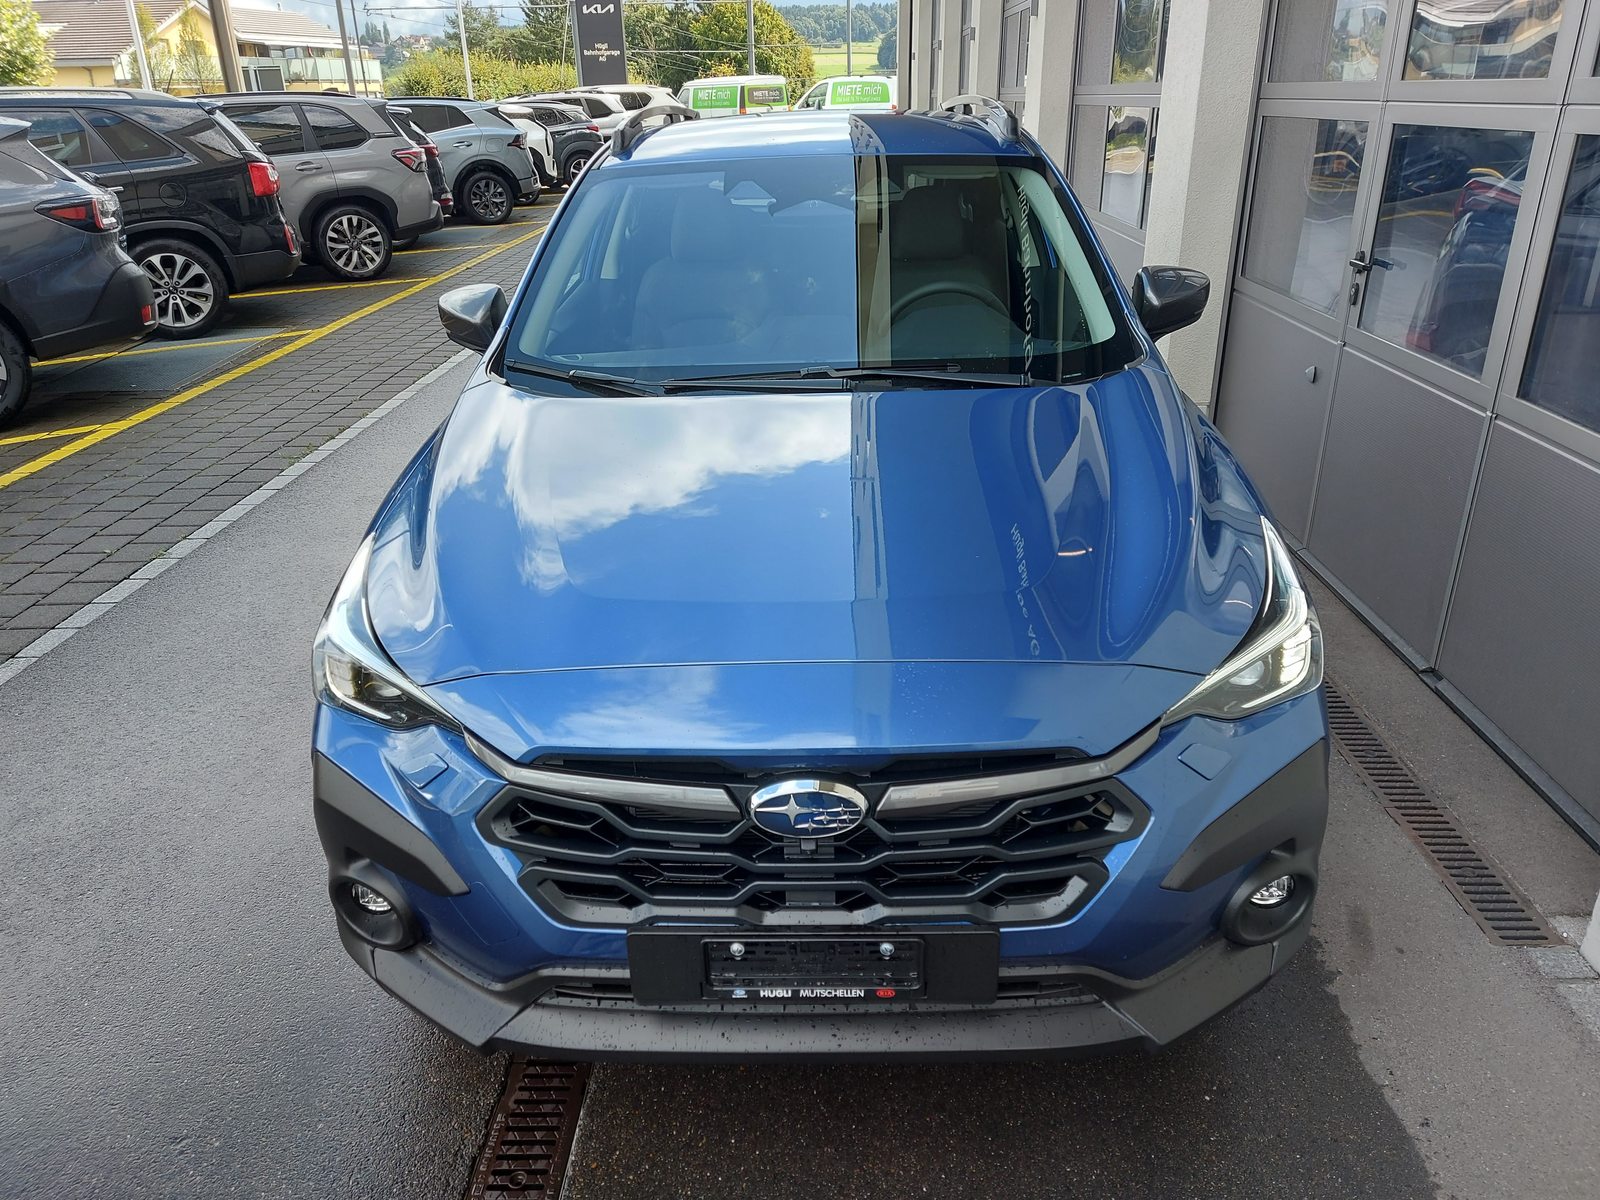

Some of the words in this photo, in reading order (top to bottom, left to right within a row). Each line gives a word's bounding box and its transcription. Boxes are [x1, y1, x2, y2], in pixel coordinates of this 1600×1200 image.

[582, 3, 615, 14] KIA
[697, 89, 717, 100] MIETE
[717, 89, 731, 99] mich
[836, 84, 862, 96] MIETE
[863, 83, 882, 95] mich
[800, 989, 865, 998] MUTSCHELLEN
